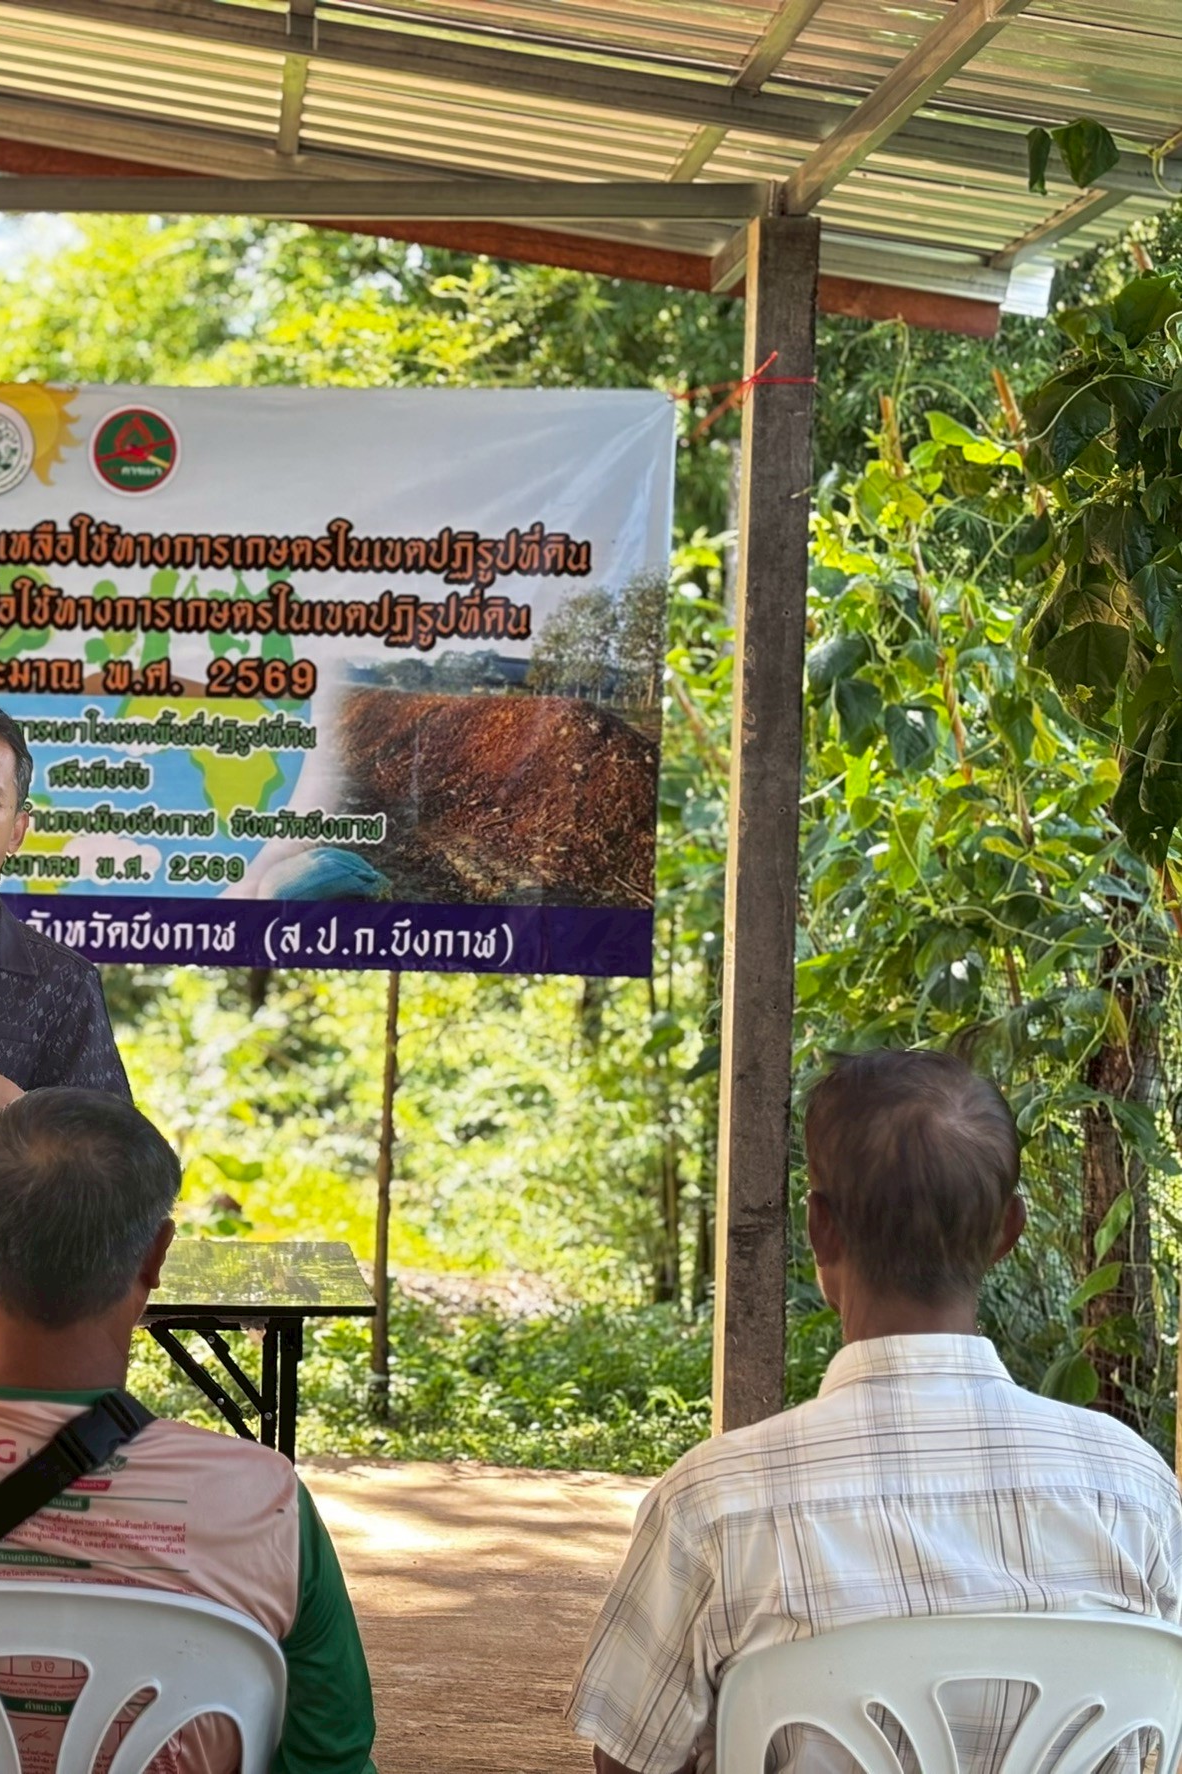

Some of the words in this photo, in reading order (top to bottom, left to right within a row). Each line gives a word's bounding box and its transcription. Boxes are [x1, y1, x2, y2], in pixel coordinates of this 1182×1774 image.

[103, 656, 184, 697] พ.ศ.
[206, 656, 317, 698] 2569
[23, 801, 215, 838] ำเภอเมืองบึงกาฬ
[231, 807, 385, 842] จังหวัดบึงกาฬ
[96, 854, 151, 881] พ.ศ.
[169, 855, 245, 883] 2569
[263, 915, 514, 968] (ส.ป.ก.บึงกาฬ)
